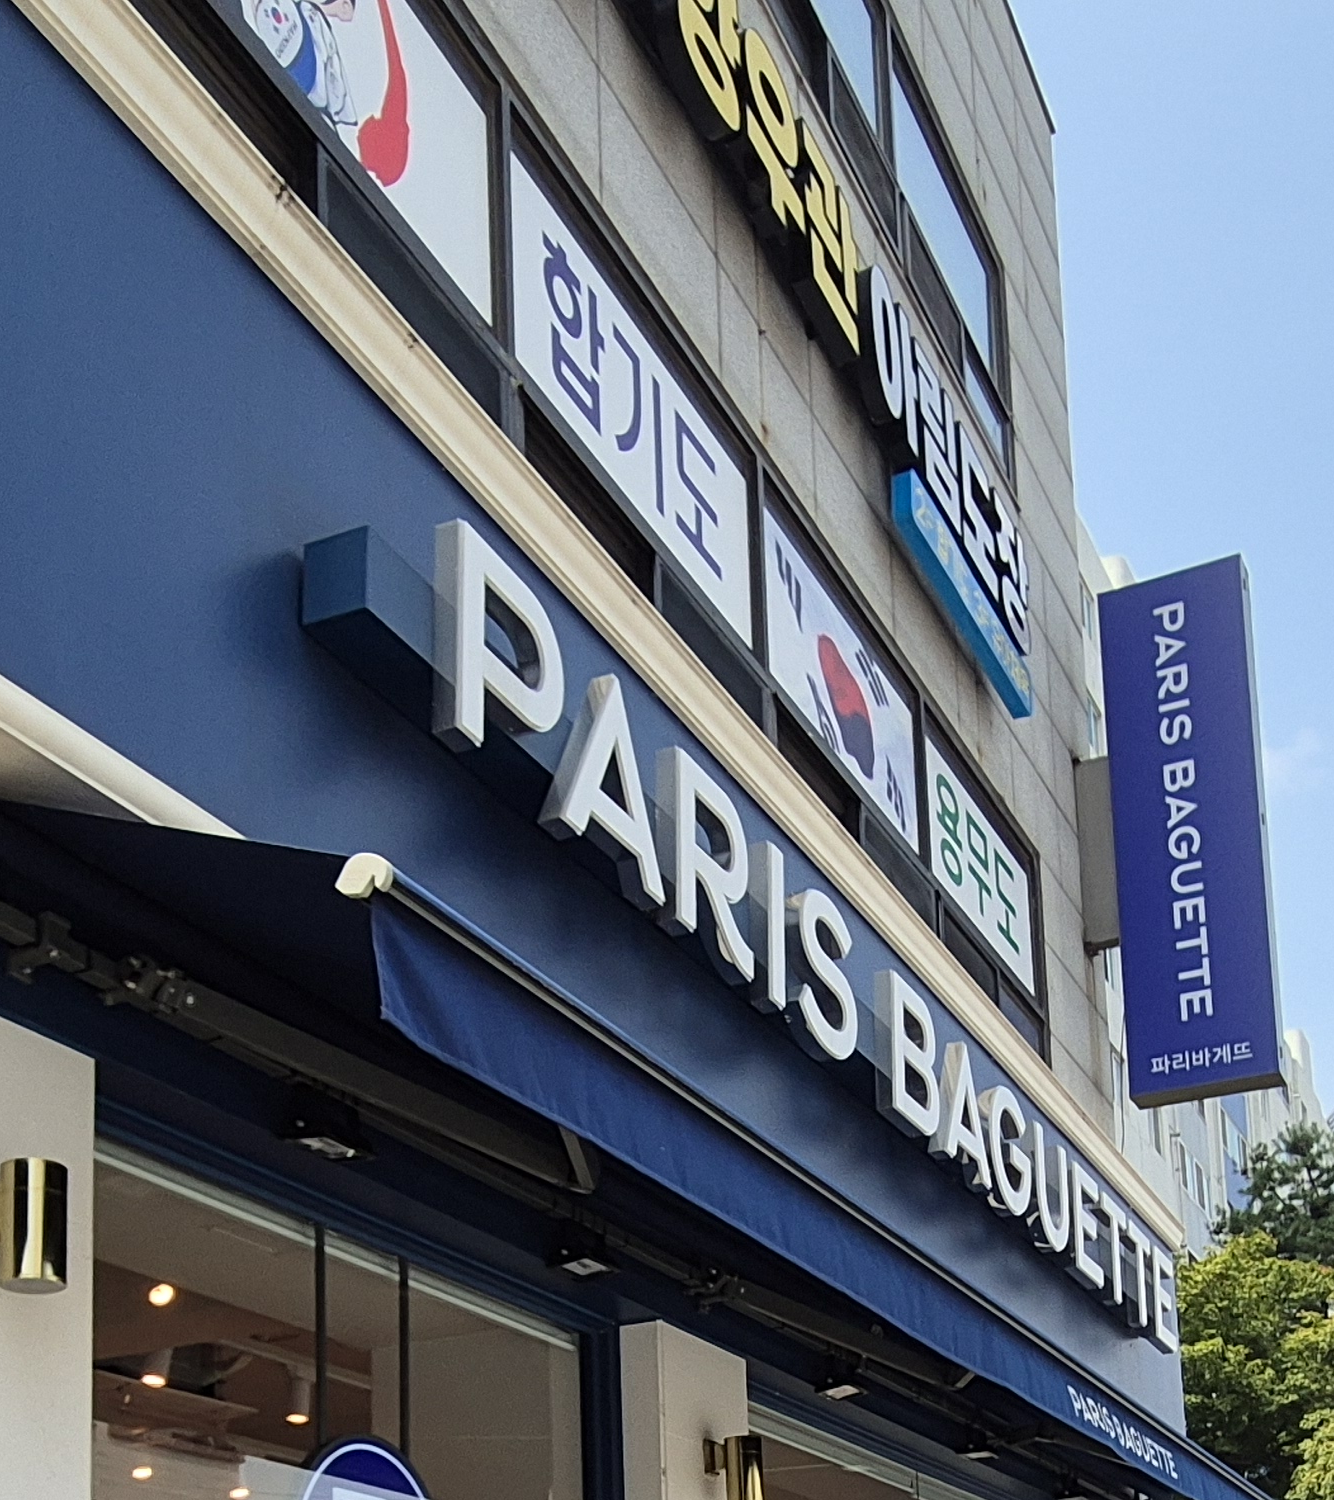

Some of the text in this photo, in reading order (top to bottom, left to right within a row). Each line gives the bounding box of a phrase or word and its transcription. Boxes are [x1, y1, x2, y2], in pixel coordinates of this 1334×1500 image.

[542, 231, 723, 581] 합기도
[870, 264, 1032, 656] 아림도장
[433, 518, 858, 1062] PARIS
[874, 969, 1179, 1355] BAGUETTE
[936, 773, 1020, 955] 용무도
[1153, 600, 1214, 1023] PARIS BAGUETTE
[1150, 1041, 1254, 1076] 파리바게뜨
[1067, 1384, 1178, 1480] PARIS BAGUETTE
